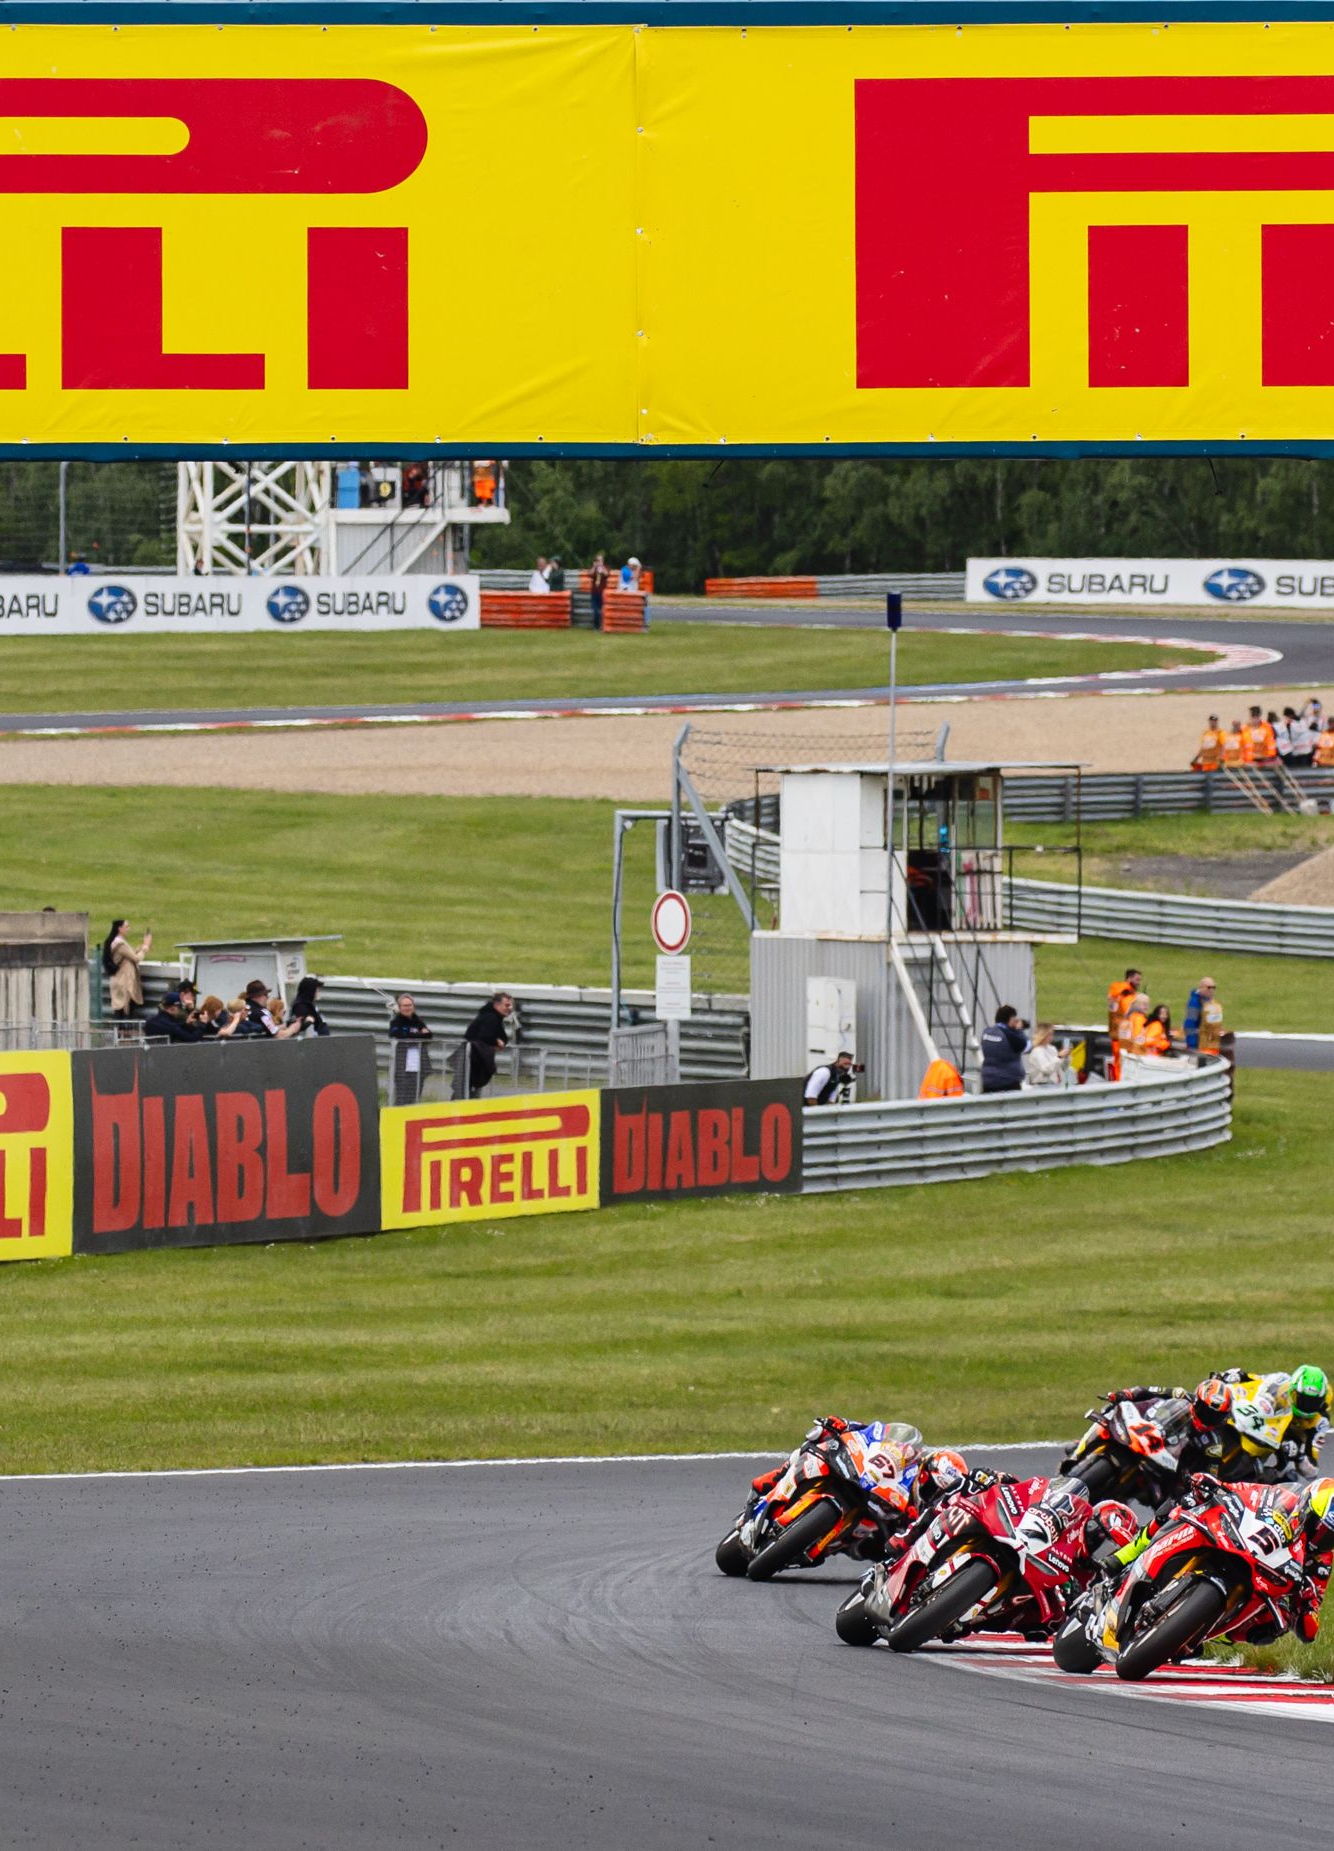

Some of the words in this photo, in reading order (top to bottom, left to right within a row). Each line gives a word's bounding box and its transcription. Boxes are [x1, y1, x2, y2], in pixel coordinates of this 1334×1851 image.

[1048, 574, 1169, 595] SUBARU
[145, 593, 242, 618] SUBARU
[317, 592, 406, 617] SUBARU
[91, 1060, 362, 1234] DIABLO
[403, 1104, 591, 1211] PIRELLI
[612, 1096, 792, 1194] DIABLO
[868, 1453, 896, 1480] 67
[1000, 1486, 1019, 1515] Lenovo
[1048, 1553, 1070, 1573] Lenovo
